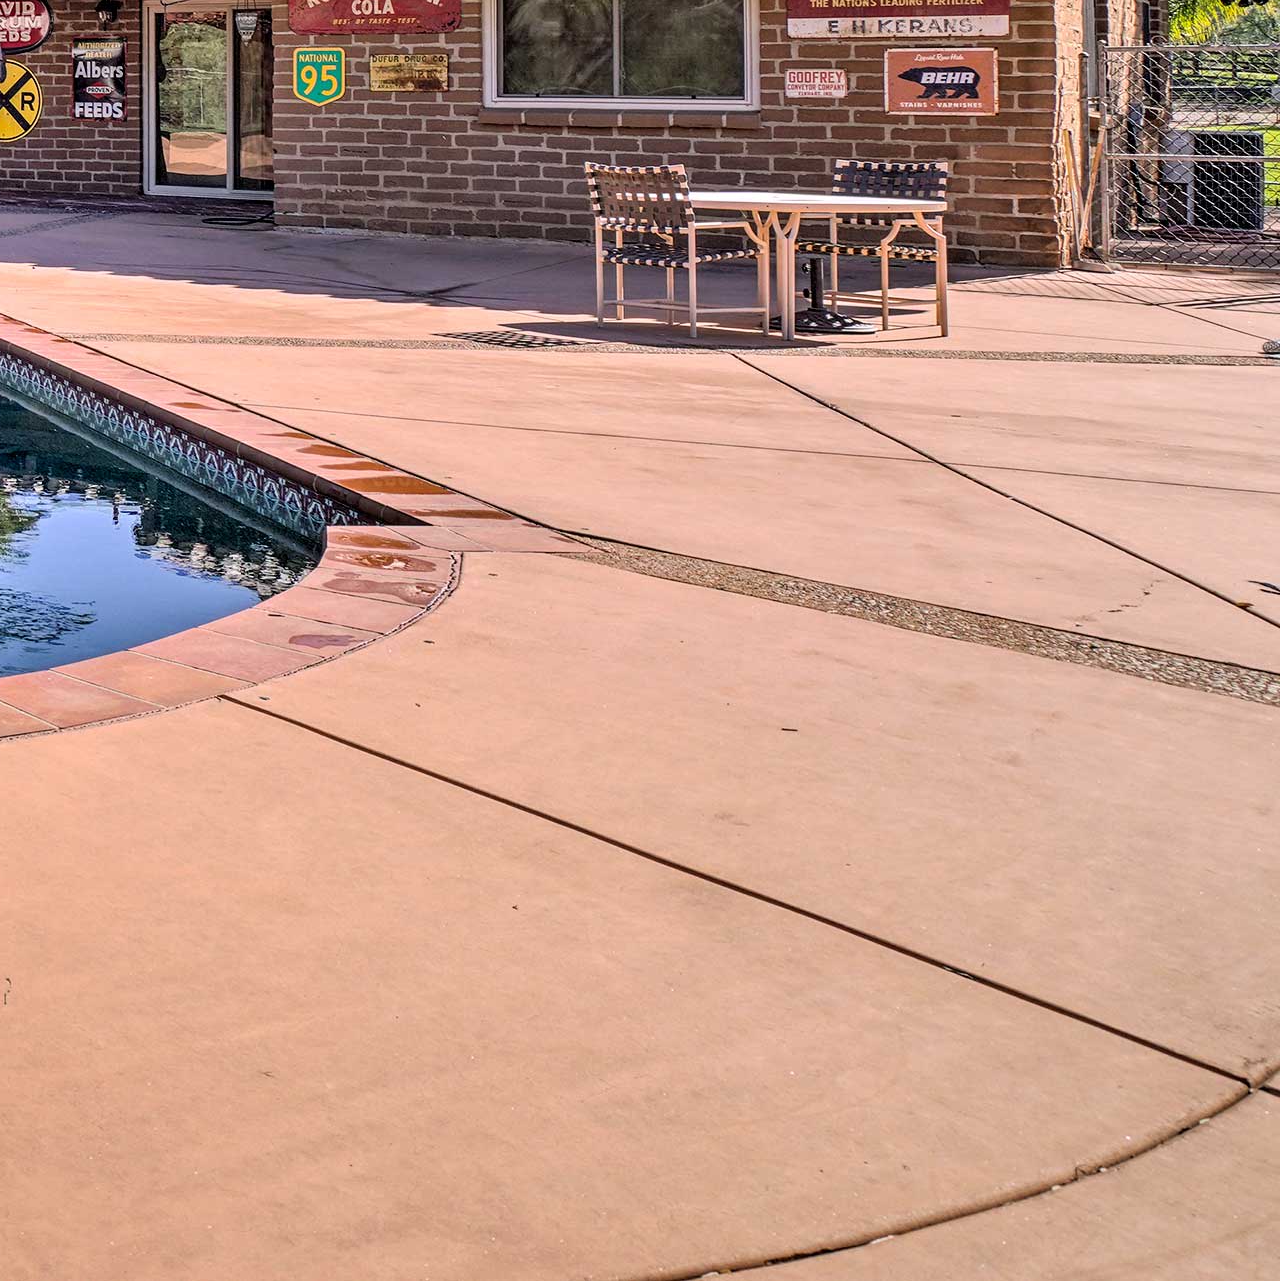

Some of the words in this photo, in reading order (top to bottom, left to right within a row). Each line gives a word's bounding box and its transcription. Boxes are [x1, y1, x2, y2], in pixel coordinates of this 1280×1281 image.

[351, 0, 395, 15] COLA
[809, 0, 829, 8] THE
[0, 30, 31, 42] EDS
[299, 54, 338, 63] NATIONAL
[372, 55, 399, 63] DUFUR
[404, 55, 427, 63] DRUG
[432, 55, 447, 63] CO.
[74, 60, 124, 78] Albers
[300, 64, 338, 95] 95
[788, 71, 843, 83] GODFREY
[920, 72, 975, 84] BEHR
[20, 92, 35, 111] R
[74, 102, 124, 118] FEEDS
